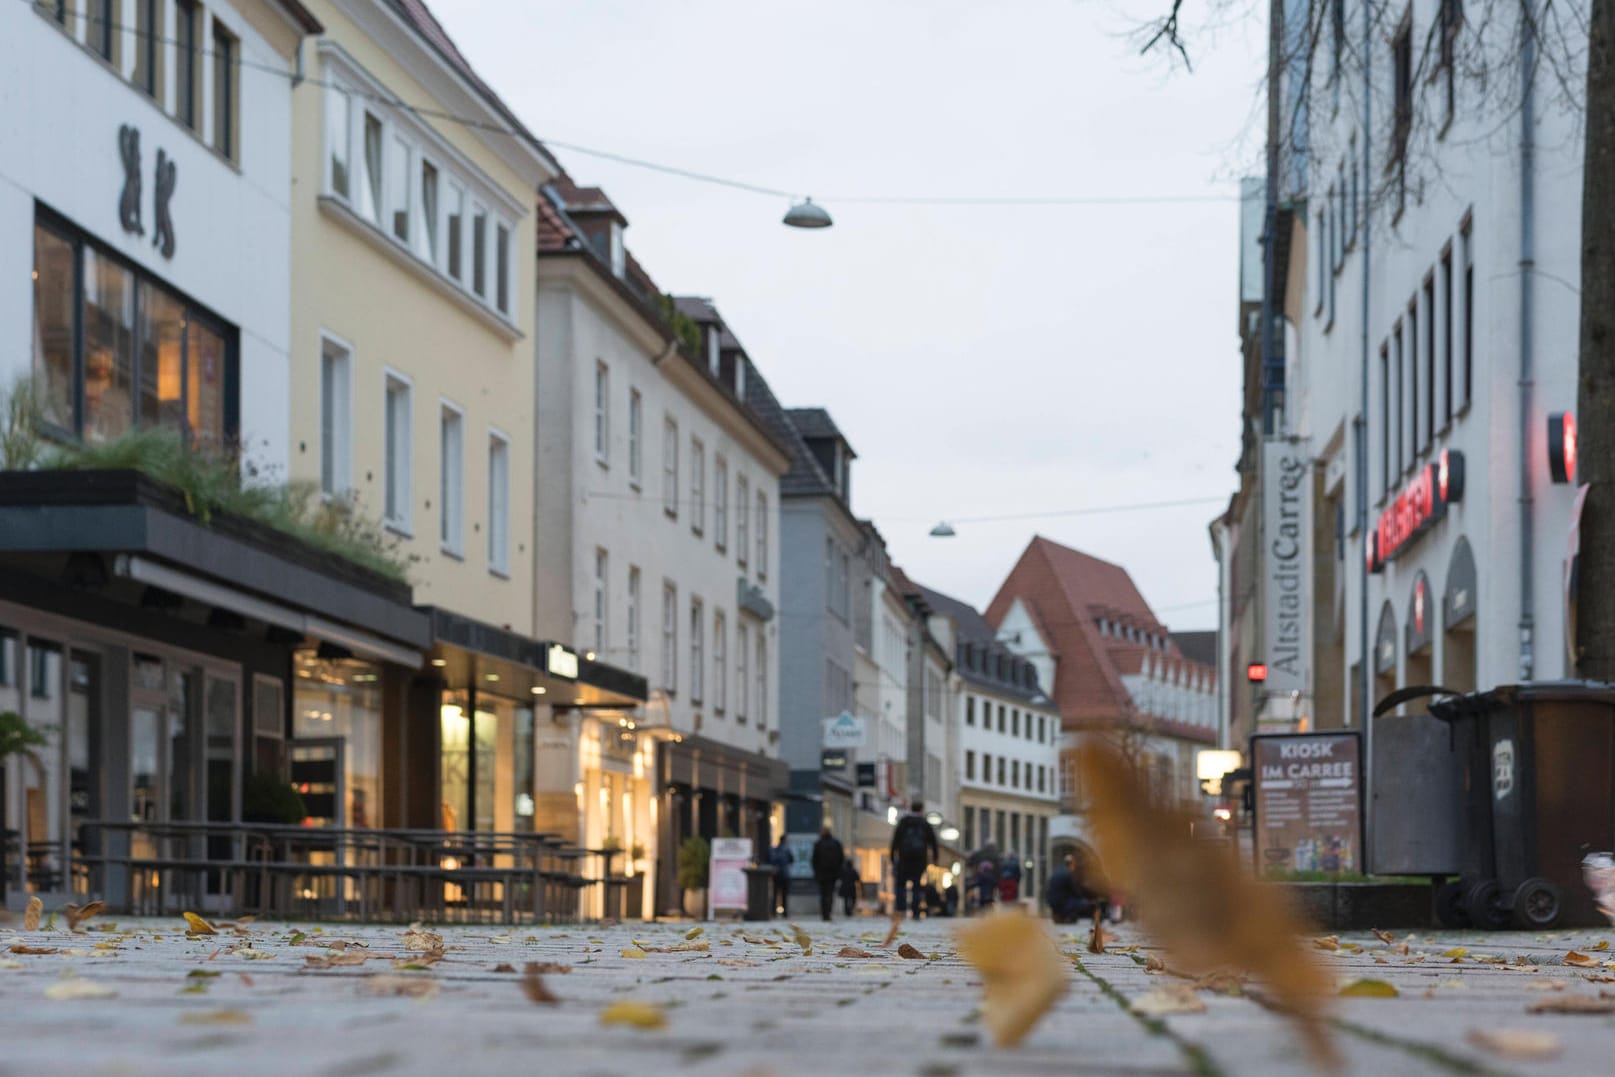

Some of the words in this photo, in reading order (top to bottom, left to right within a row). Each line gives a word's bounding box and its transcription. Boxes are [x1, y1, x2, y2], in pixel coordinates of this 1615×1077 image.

[1280, 743, 1333, 759] KIOSK
[1262, 765, 1284, 778] IM
[1287, 762, 1352, 778] CARREE
